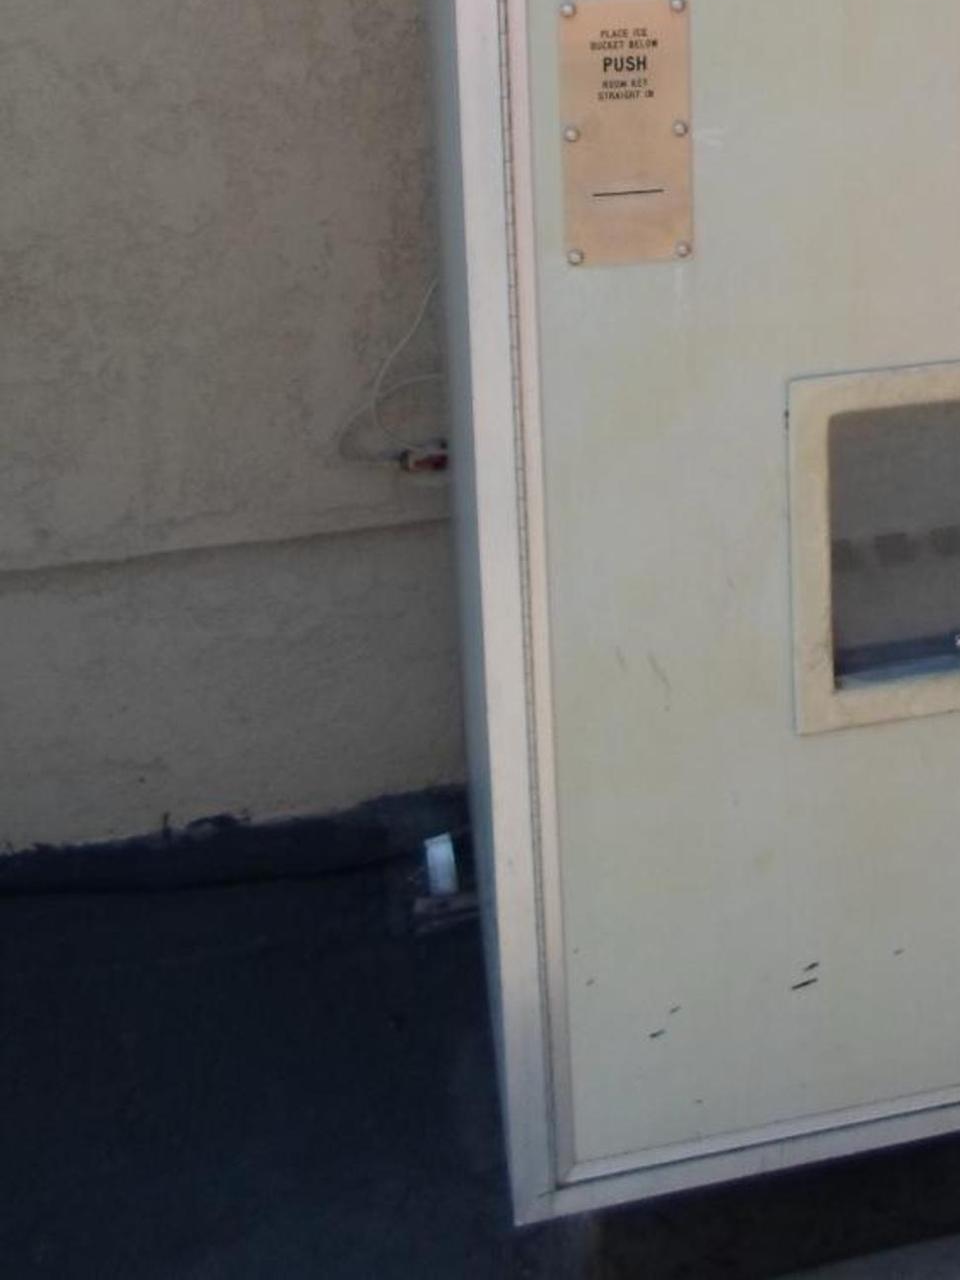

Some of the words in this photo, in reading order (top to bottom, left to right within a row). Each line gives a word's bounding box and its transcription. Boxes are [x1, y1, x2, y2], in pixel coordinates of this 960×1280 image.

[600, 28, 628, 38] PLACE
[632, 28, 648, 37] ICE
[628, 39, 658, 49] BELOW
[603, 55, 646, 72] PUSH
[597, 90, 640, 101] STRAIGHT
